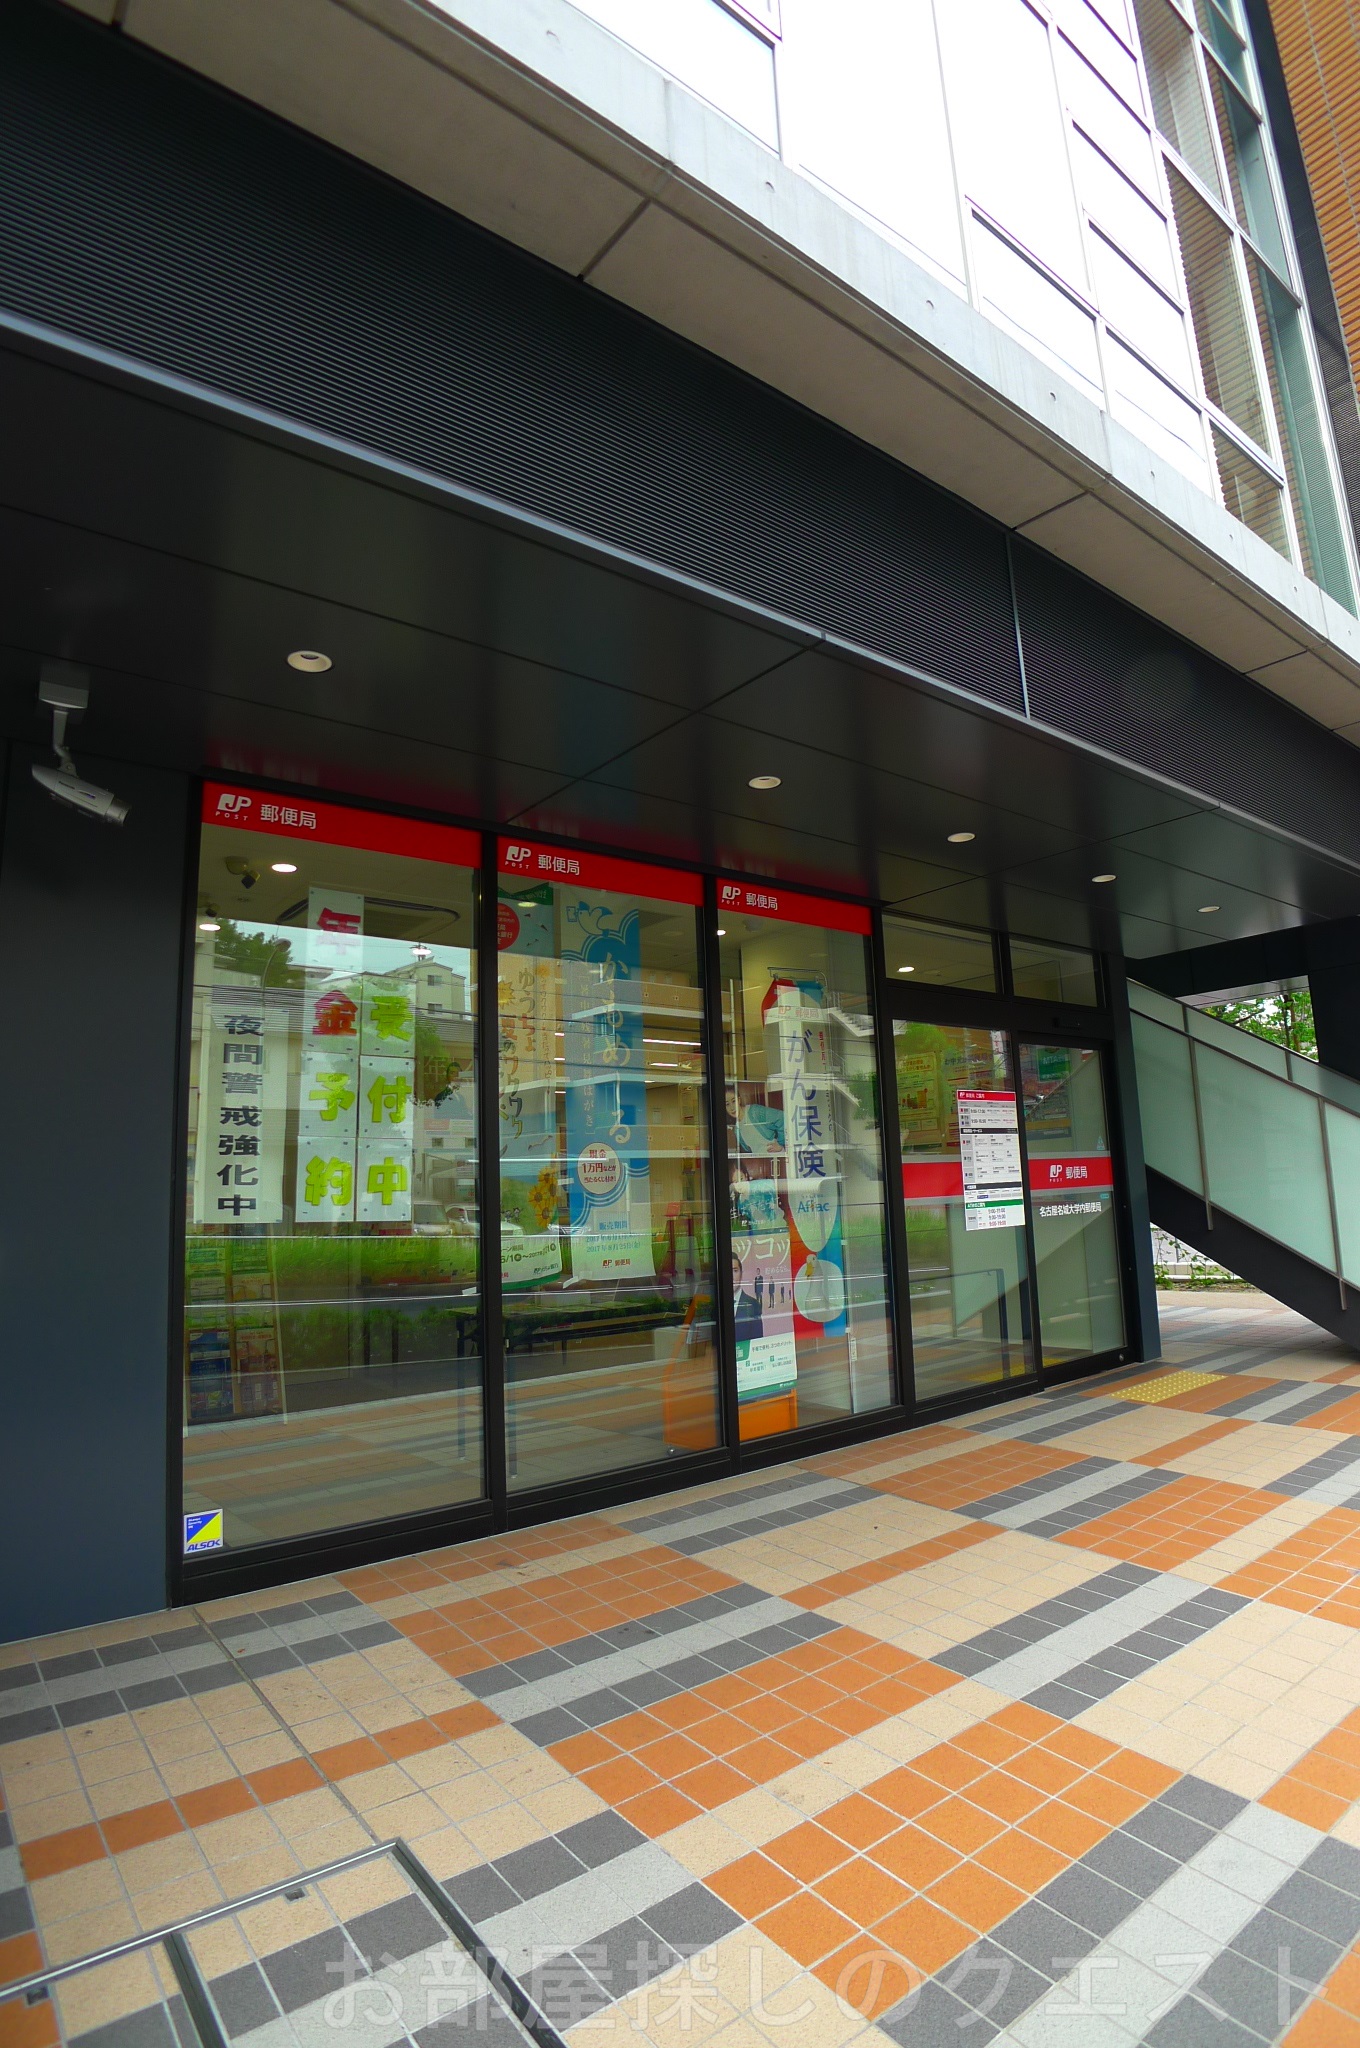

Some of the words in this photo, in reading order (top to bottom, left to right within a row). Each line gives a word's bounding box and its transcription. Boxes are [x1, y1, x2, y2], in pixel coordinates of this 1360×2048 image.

[215, 811, 248, 821] POST
[260, 804, 317, 829] 郵便局
[504, 861, 530, 869] POST
[538, 854, 580, 875] 郵便局
[745, 892, 778, 910] 郵便局
[519, 967, 536, 1052] ゆうちょ
[305, 907, 361, 1206] 年金予約
[366, 995, 413, 1206] 受付中
[786, 1029, 827, 1178] がん保険
[217, 1014, 265, 1217] 夜間警戒強化中
[589, 1149, 607, 1158] 現金
[1065, 1166, 1088, 1179] 郵便局
[1039, 1202, 1102, 1217] 名古屋名城大学内郵便局
[187, 1539, 221, 1551] ALSOK
